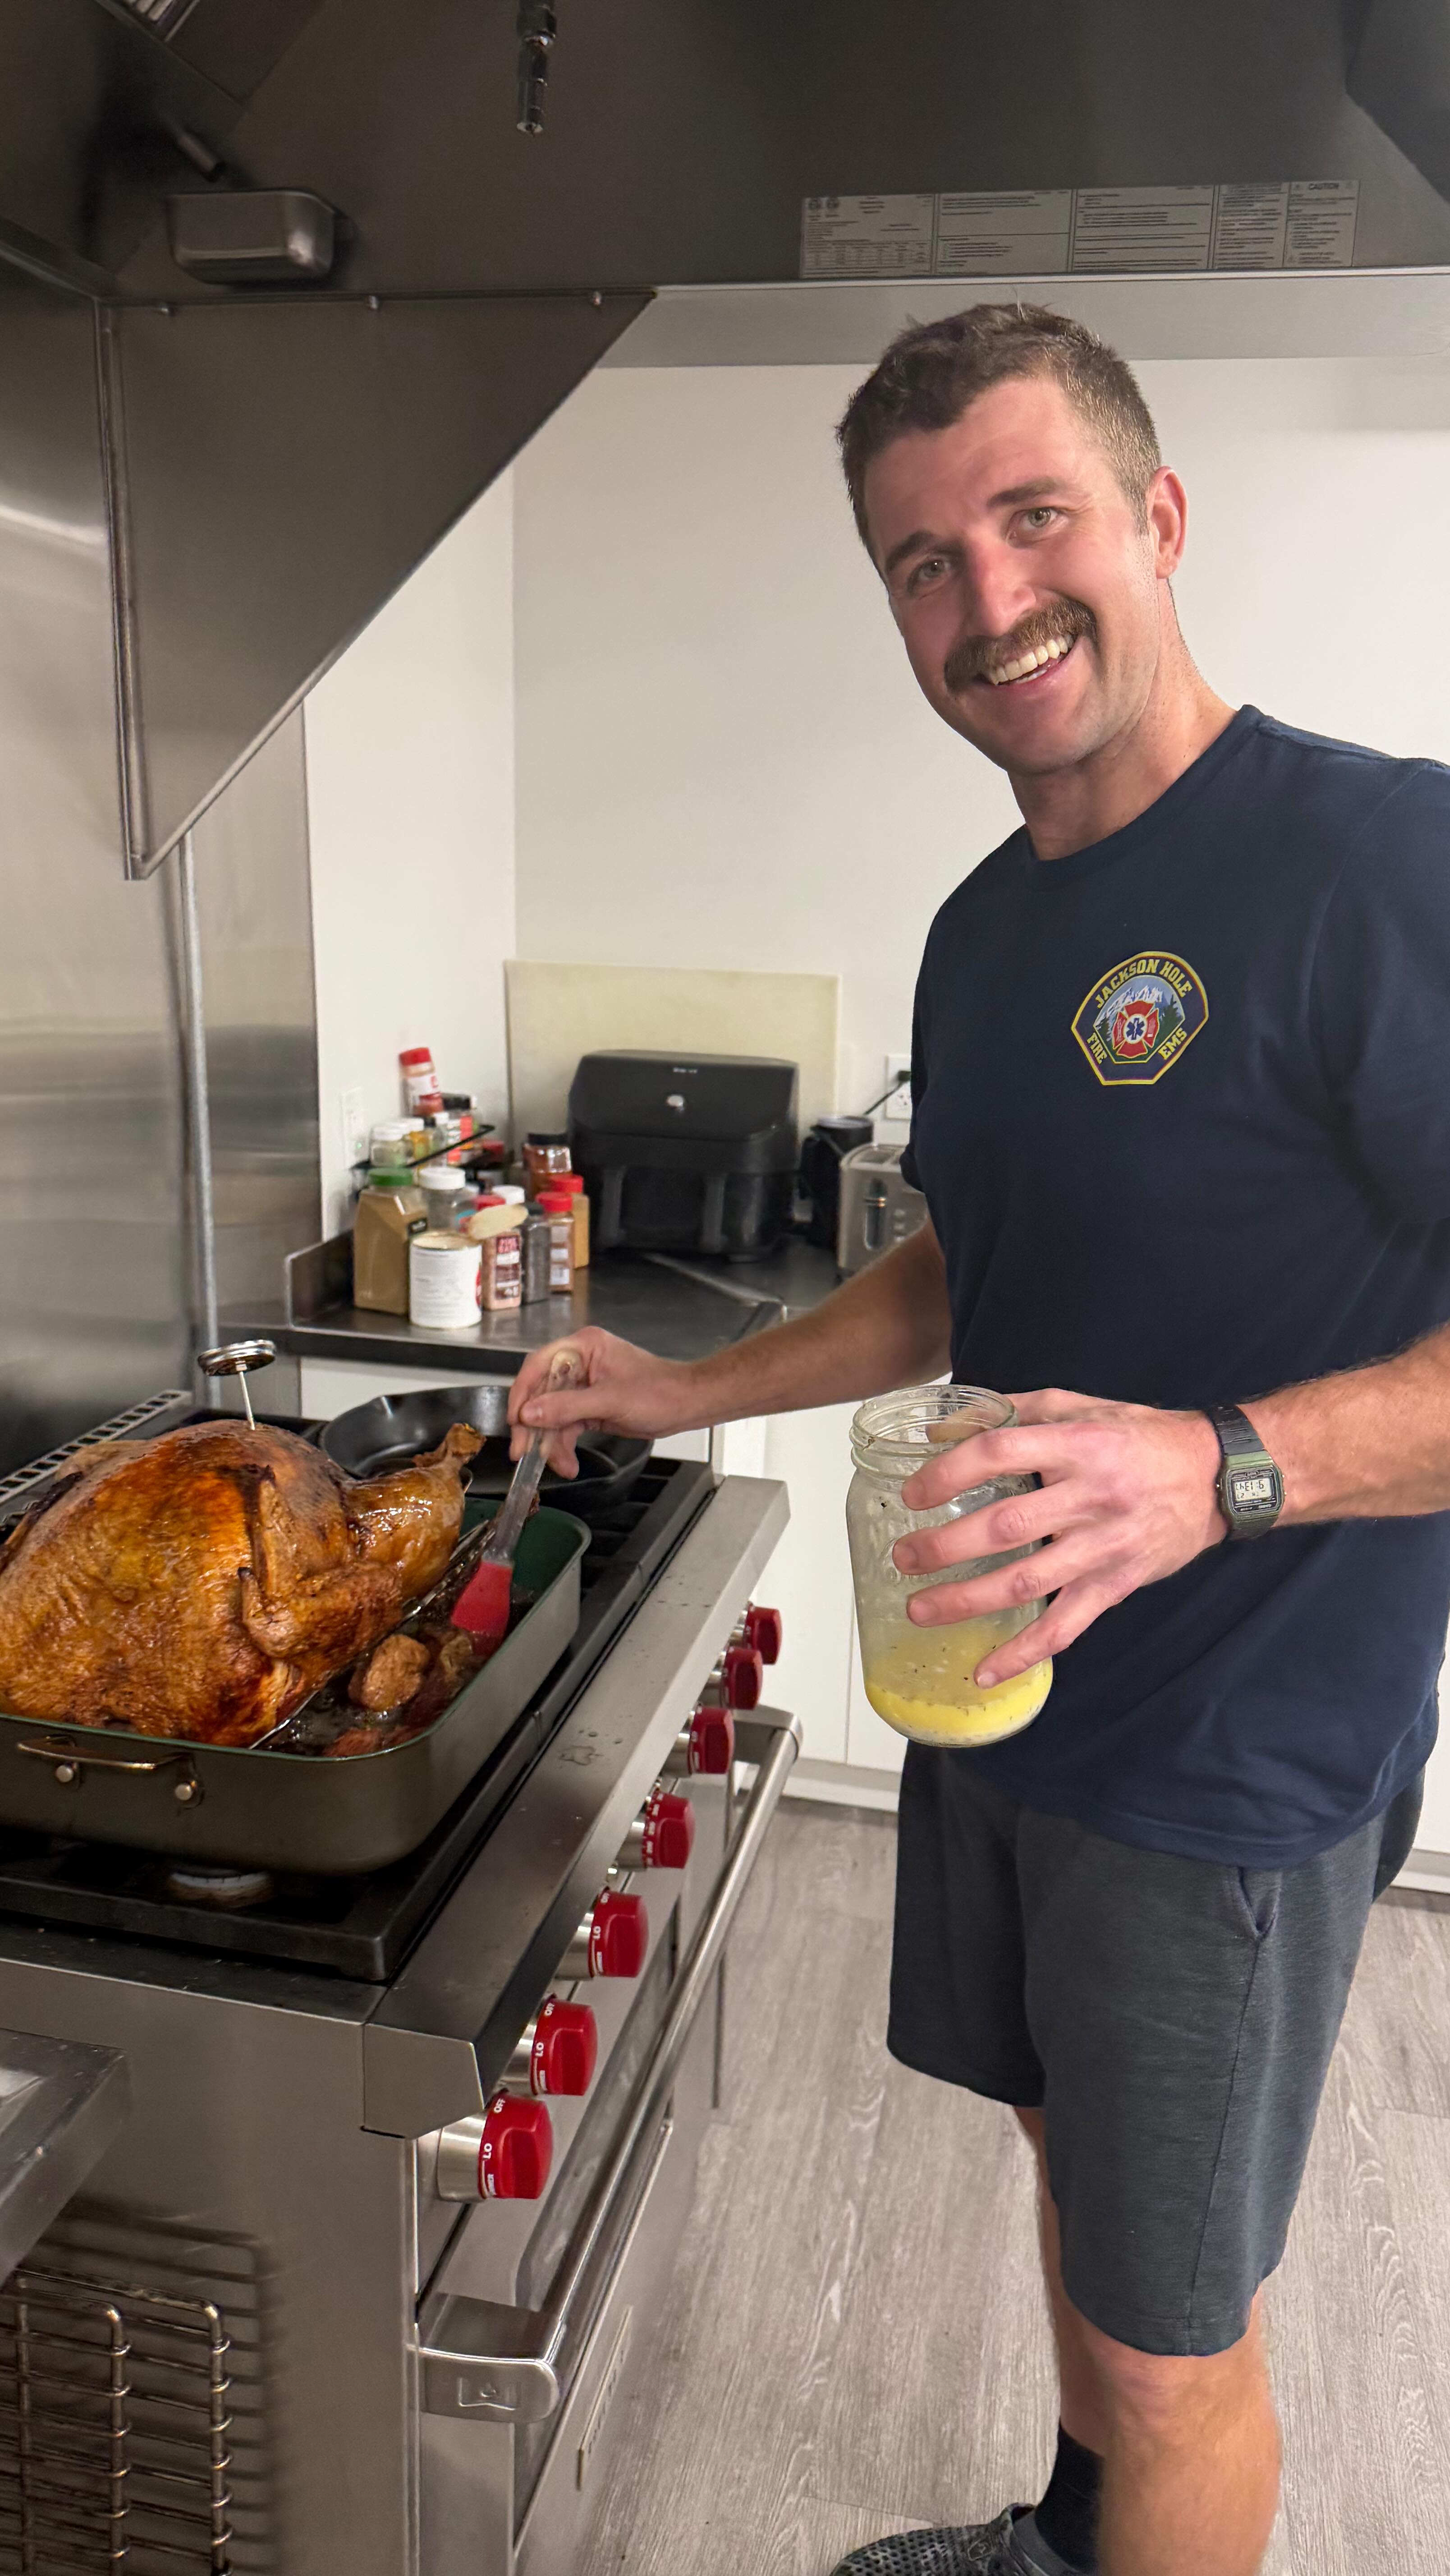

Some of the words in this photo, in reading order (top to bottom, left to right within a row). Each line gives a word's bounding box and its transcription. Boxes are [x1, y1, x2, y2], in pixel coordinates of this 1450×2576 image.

[1095, 958, 1160, 1009] JACKSON
[1159, 961, 1193, 998] HOLE
[1086, 1032, 1107, 1065] FIRE
[1157, 1027, 1188, 1060] EMS
[592, 1925, 601, 1940] LO
[544, 2002, 555, 2016] OFF
[535, 2041, 544, 2057] LO
[493, 2098, 506, 2113] OFF
[482, 2142, 492, 2160] LO
